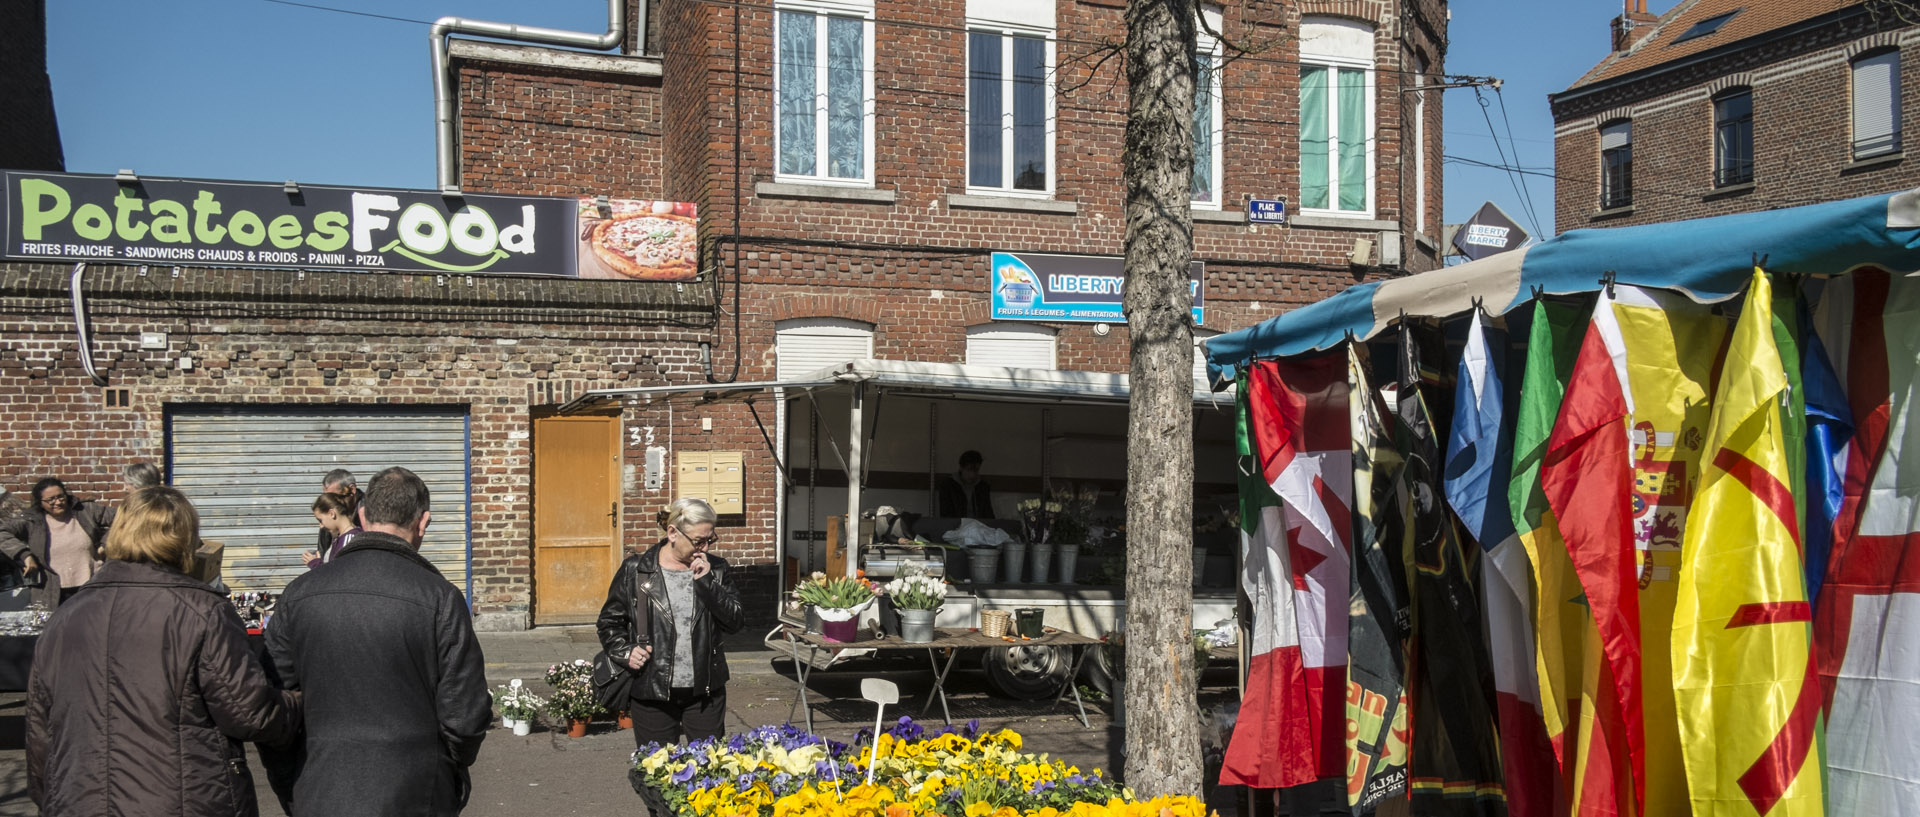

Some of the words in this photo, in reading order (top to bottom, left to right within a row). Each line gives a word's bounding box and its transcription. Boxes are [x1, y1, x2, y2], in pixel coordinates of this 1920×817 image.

[1259, 203, 1275, 211] PLACE
[1470, 225, 1508, 236] LIBERTY
[1468, 235, 1506, 247] MARKET
[22, 243, 61, 255] FRITES
[64, 244, 114, 257] FRAICHE
[125, 246, 195, 260] SANDWICHS
[198, 249, 244, 261] CHAUDS
[247, 251, 256, 262] &
[259, 251, 298, 263] FROIDS
[309, 253, 345, 265] PANINI
[356, 255, 385, 266] PIZZA
[1050, 275, 1123, 294] LIBERTY
[1071, 310, 1119, 318] ALIMENTATION
[629, 426, 655, 446] 33
